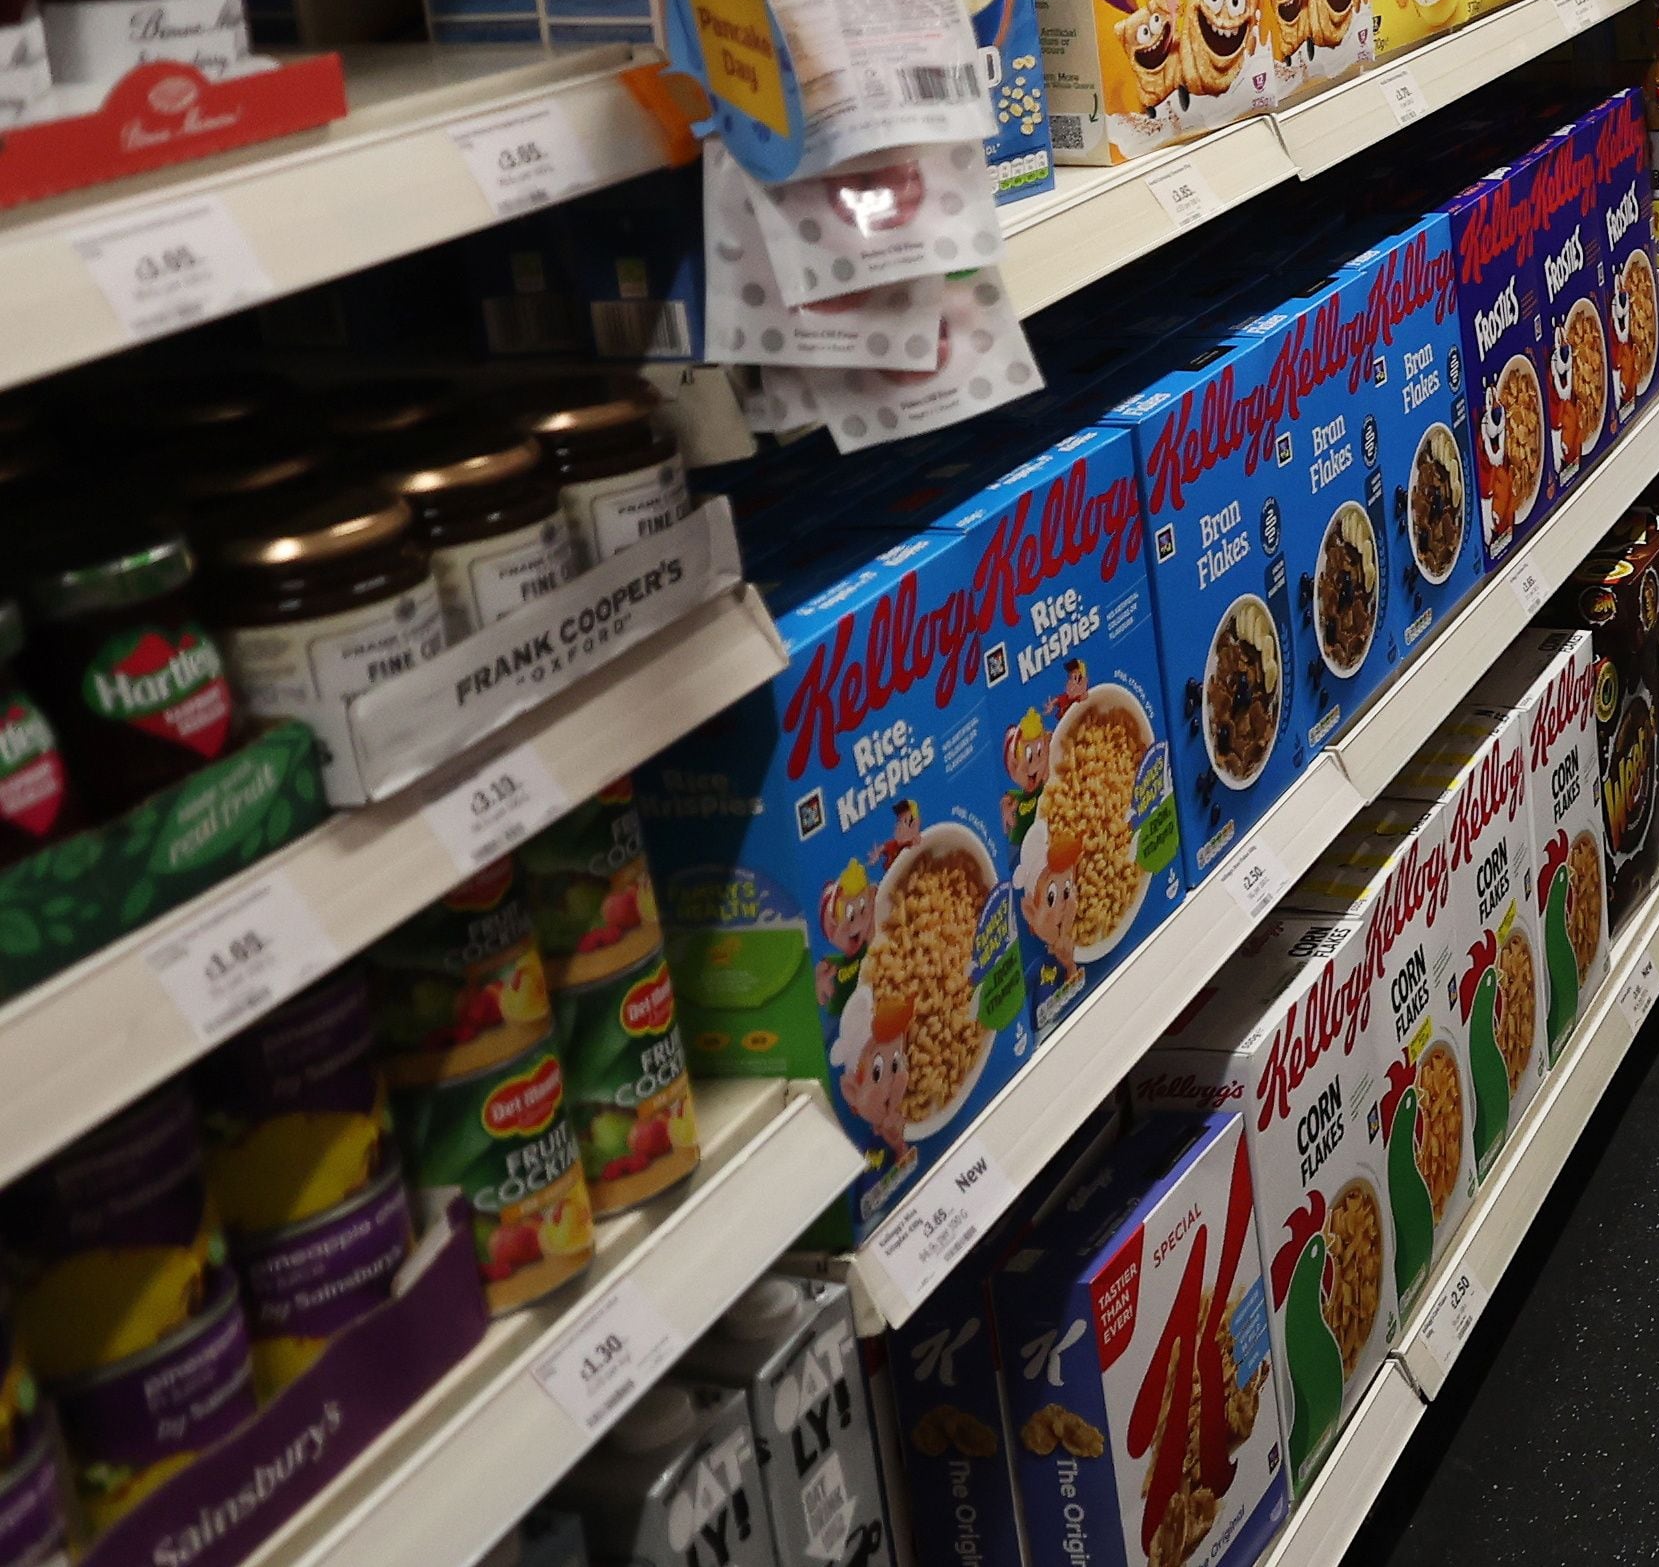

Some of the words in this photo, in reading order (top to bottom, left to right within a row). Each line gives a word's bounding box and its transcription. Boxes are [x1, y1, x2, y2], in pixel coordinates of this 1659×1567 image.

[1403, 343, 1434, 380] Bran
[1402, 369, 1440, 415] Flakes
[1312, 414, 1347, 457] Bran
[1310, 444, 1353, 495] Flakes
[1199, 500, 1241, 549] Bran
[1196, 531, 1250, 591] Flakes
[454, 629, 556, 705] FRANK
[559, 558, 684, 646] COOPER'S
[1030, 586, 1078, 636] Rice
[852, 717, 908, 778] Rice
[1551, 743, 1580, 800] CORN
[1553, 771, 1581, 825] FLAKES
[1476, 835, 1508, 898] CORN
[1479, 868, 1512, 926] FLAKES
[1391, 943, 1427, 1014] CORN
[1395, 977, 1431, 1043] FLAKES
[1296, 1073, 1343, 1157] CORN
[954, 1155, 989, 1194] New
[1301, 1115, 1345, 1189] FLAKES
[1152, 1202, 1203, 1269] SPECIAL
[1097, 1262, 1139, 1310] TASTIER
[1100, 1286, 1133, 1328] THAN
